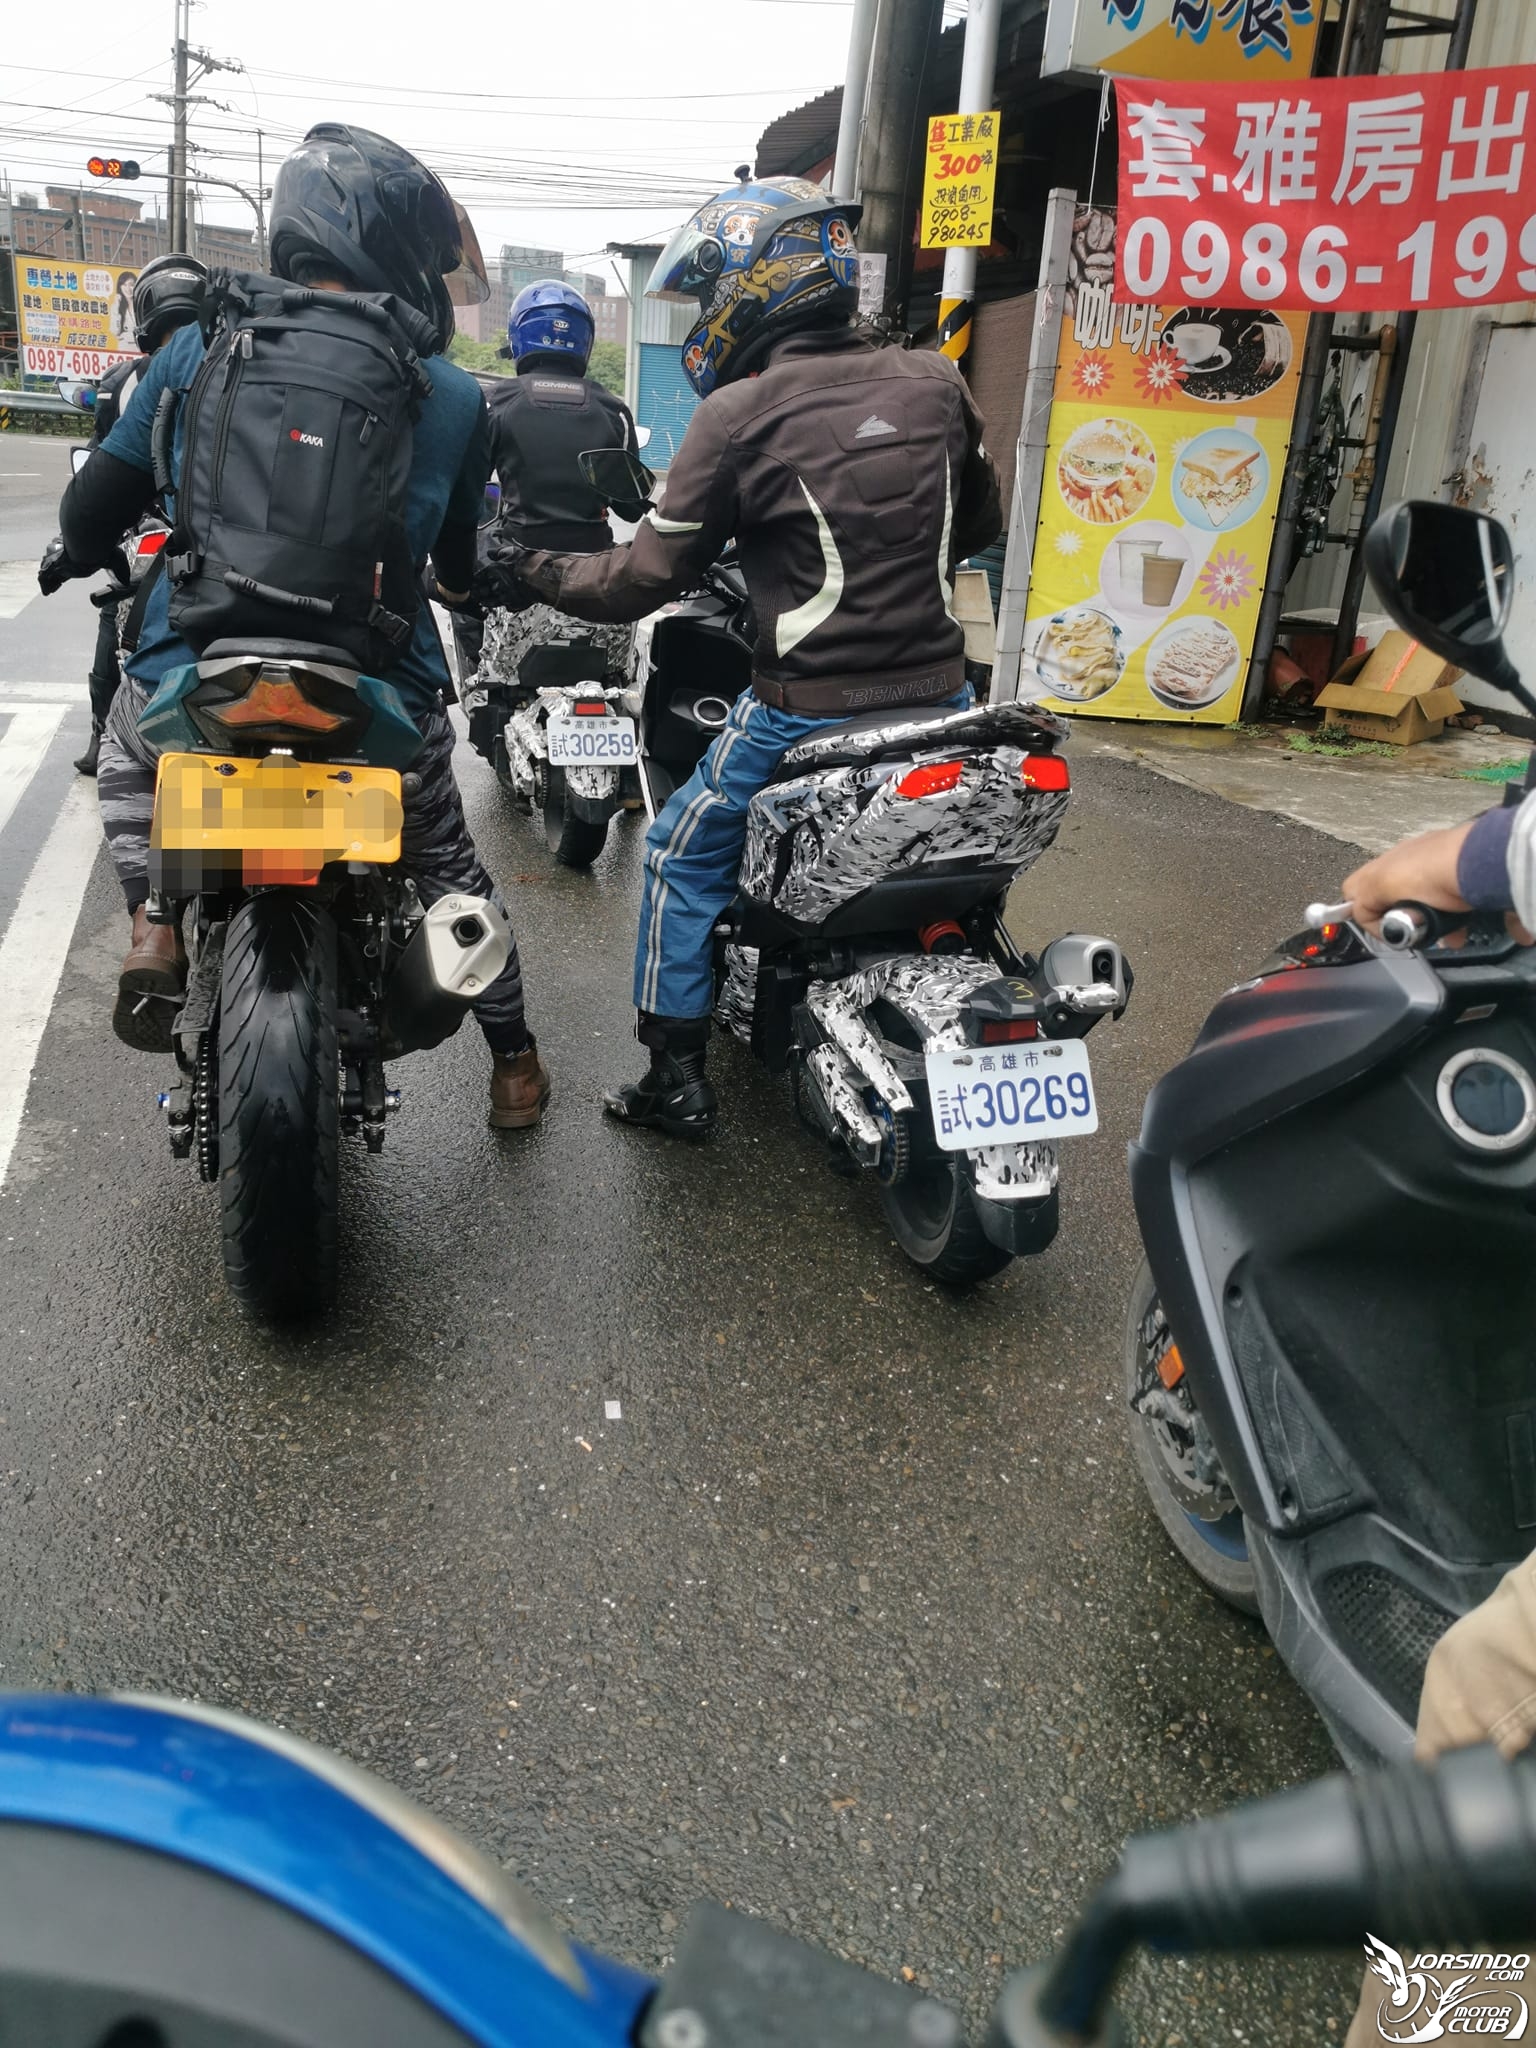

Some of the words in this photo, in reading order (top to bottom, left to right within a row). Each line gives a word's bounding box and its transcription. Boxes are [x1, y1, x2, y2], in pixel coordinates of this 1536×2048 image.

[934, 150, 993, 180] 300坪
[931, 205, 976, 226] 0908-
[928, 222, 989, 246] 980245
[27, 347, 134, 376] 0987-608-6
[300, 433, 323, 447] KAKA
[842, 673, 949, 707] BENKIA
[575, 720, 608, 729] 高雄市
[551, 733, 634, 757] 試30259
[978, 1052, 1039, 1073] 高雄市
[937, 1072, 1091, 1134] 試30269
